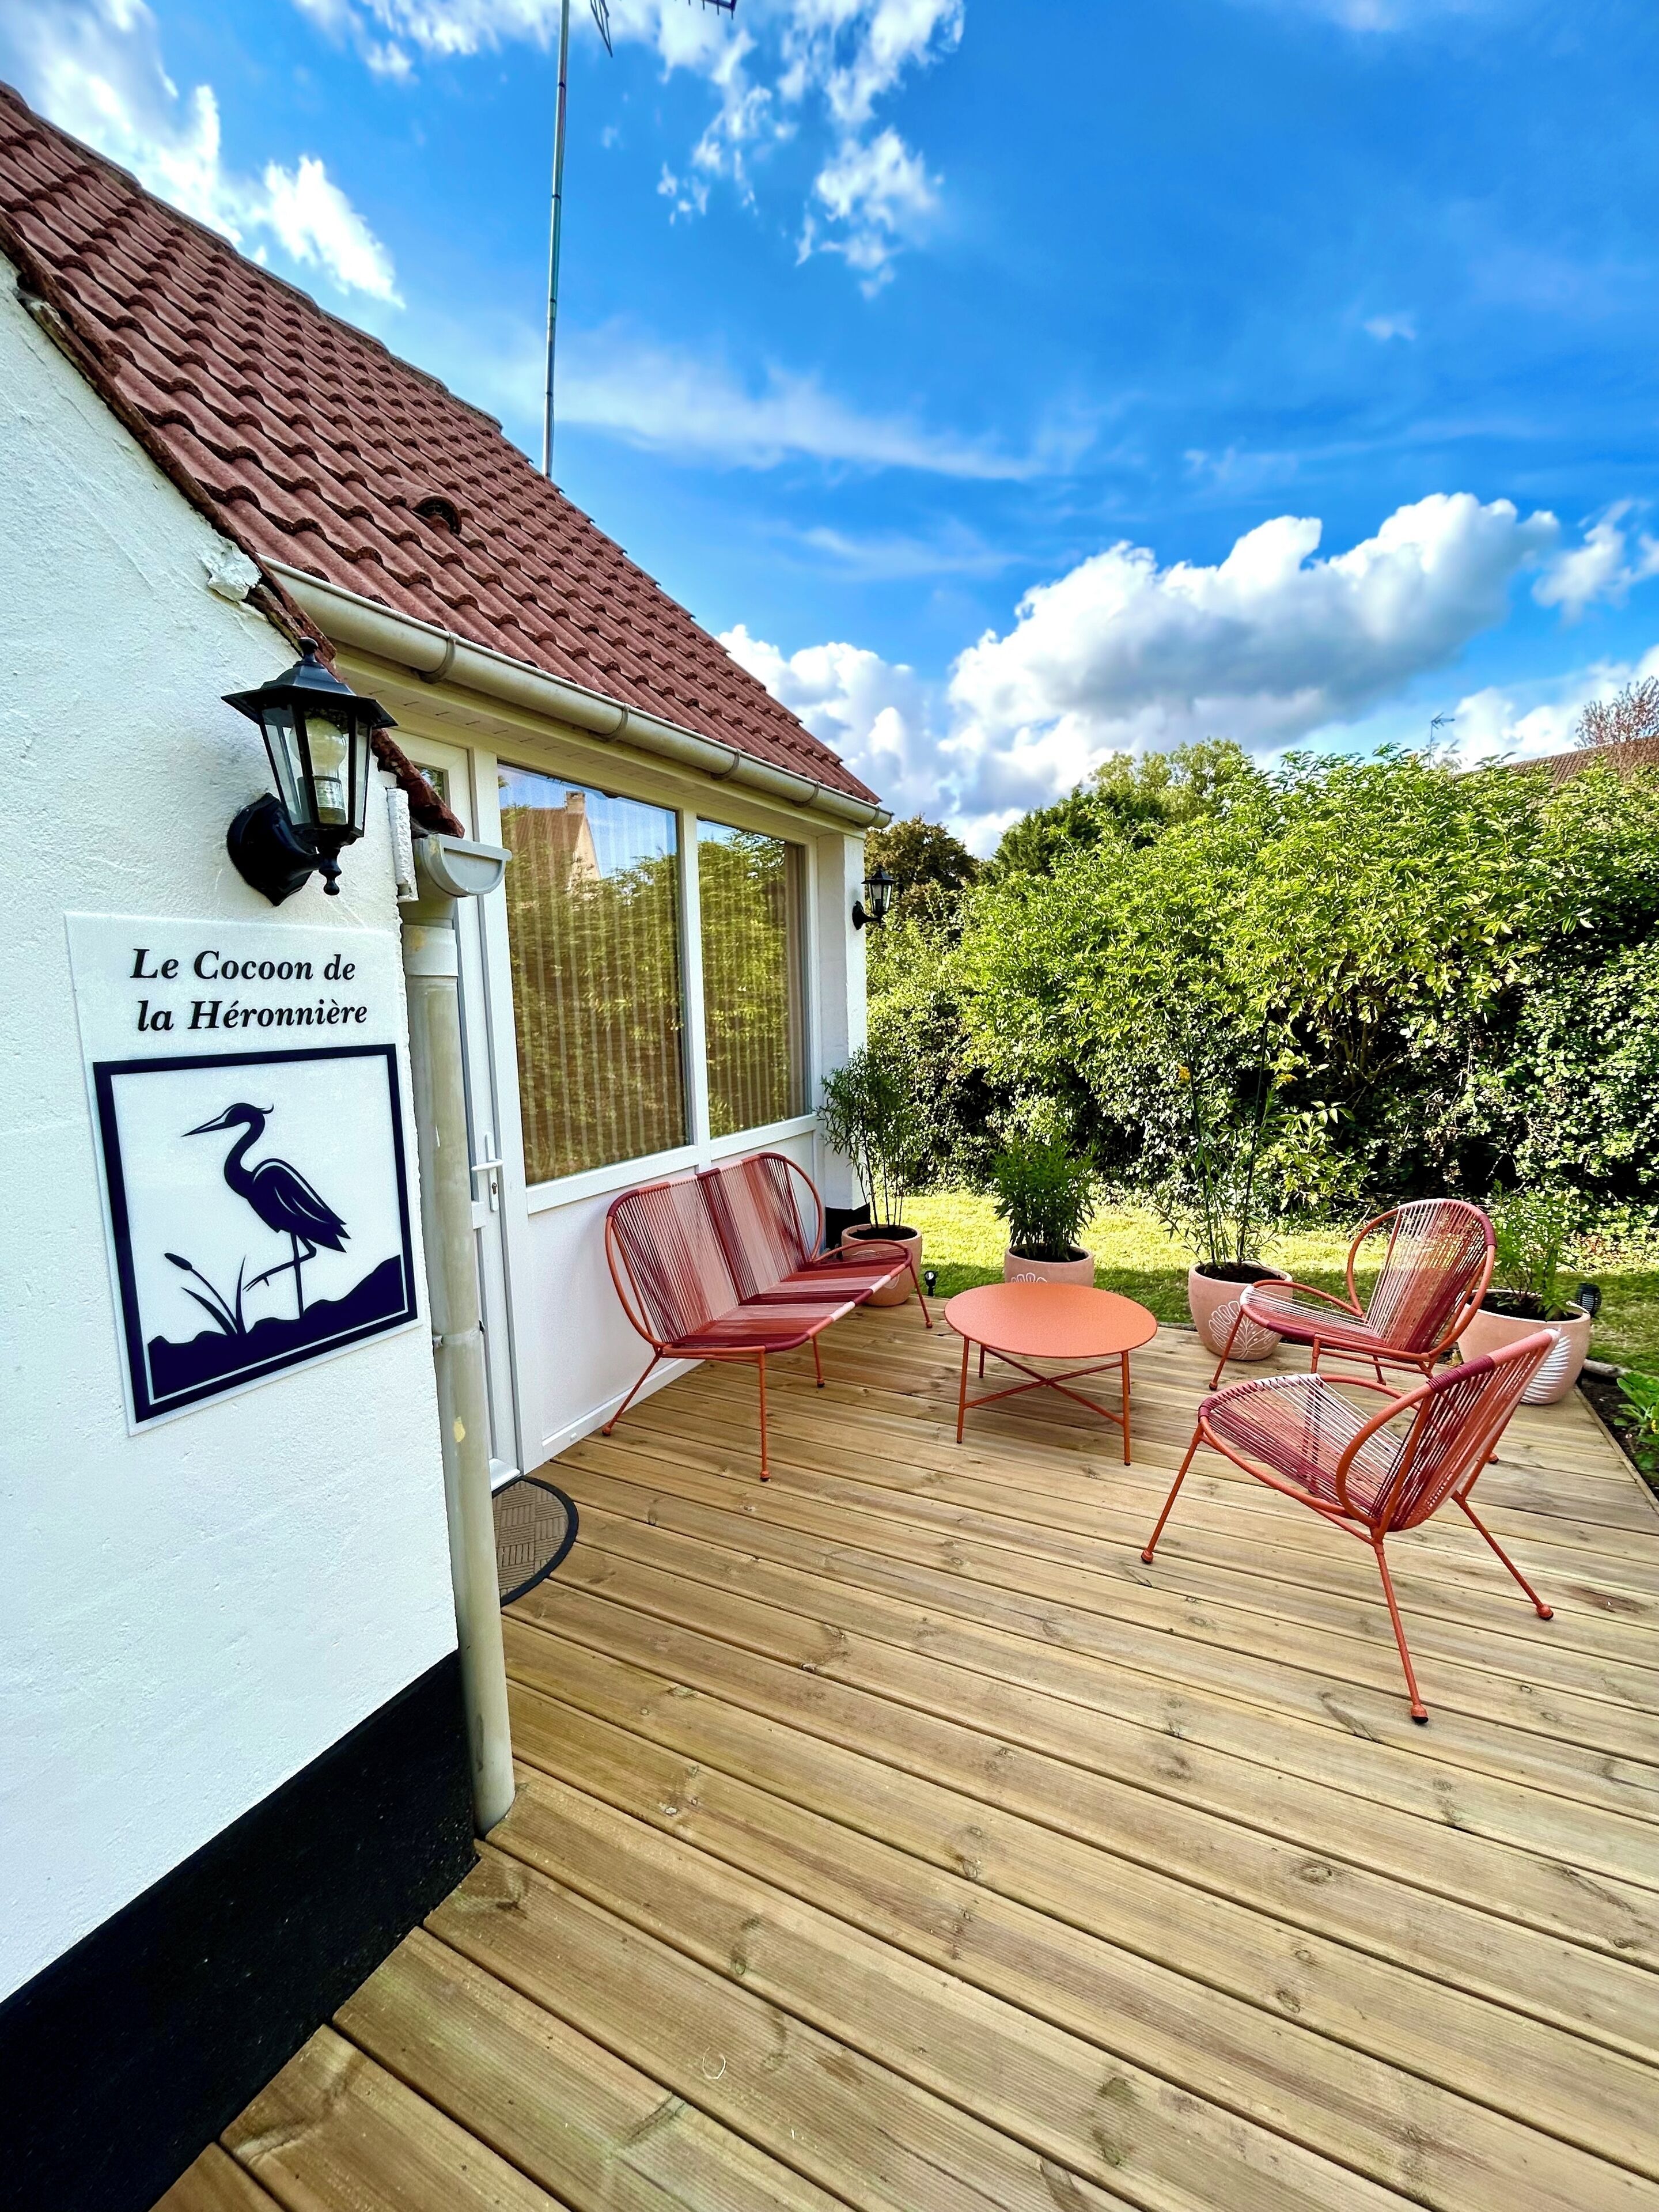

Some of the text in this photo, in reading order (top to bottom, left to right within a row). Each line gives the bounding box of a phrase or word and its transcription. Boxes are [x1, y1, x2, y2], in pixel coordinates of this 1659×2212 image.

[130, 948, 355, 980] Le Cocoon de
[138, 998, 368, 1032] la Héronnière
